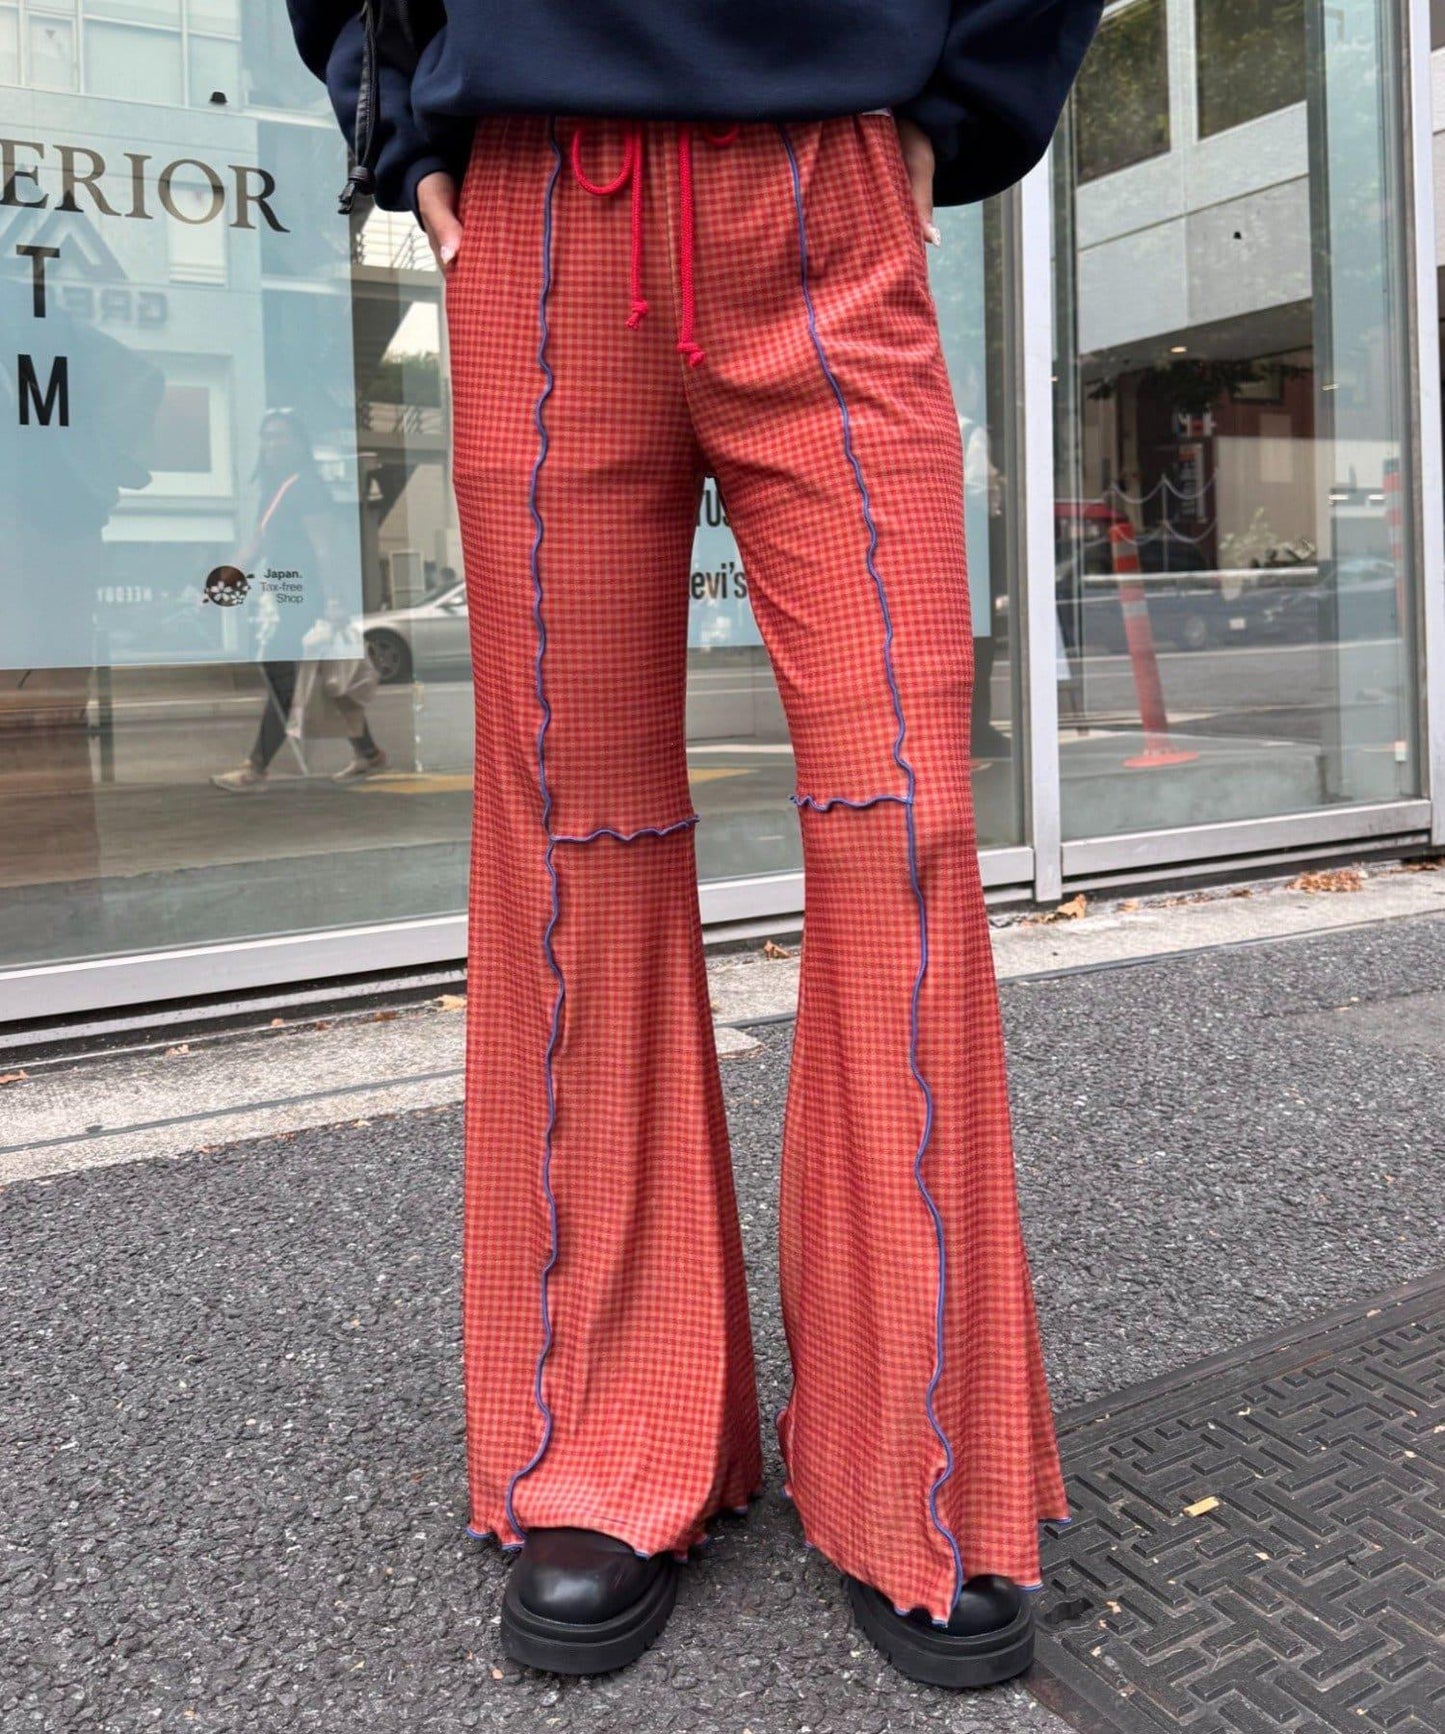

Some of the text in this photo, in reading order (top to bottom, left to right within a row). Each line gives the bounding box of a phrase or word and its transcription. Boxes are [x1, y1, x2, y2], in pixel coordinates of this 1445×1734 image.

[0, 138, 290, 233] ERIOR
[16, 244, 60, 318] T
[17, 353, 69, 427] M
[260, 581, 304, 592] Tax-free
[276, 593, 304, 605] Shop
